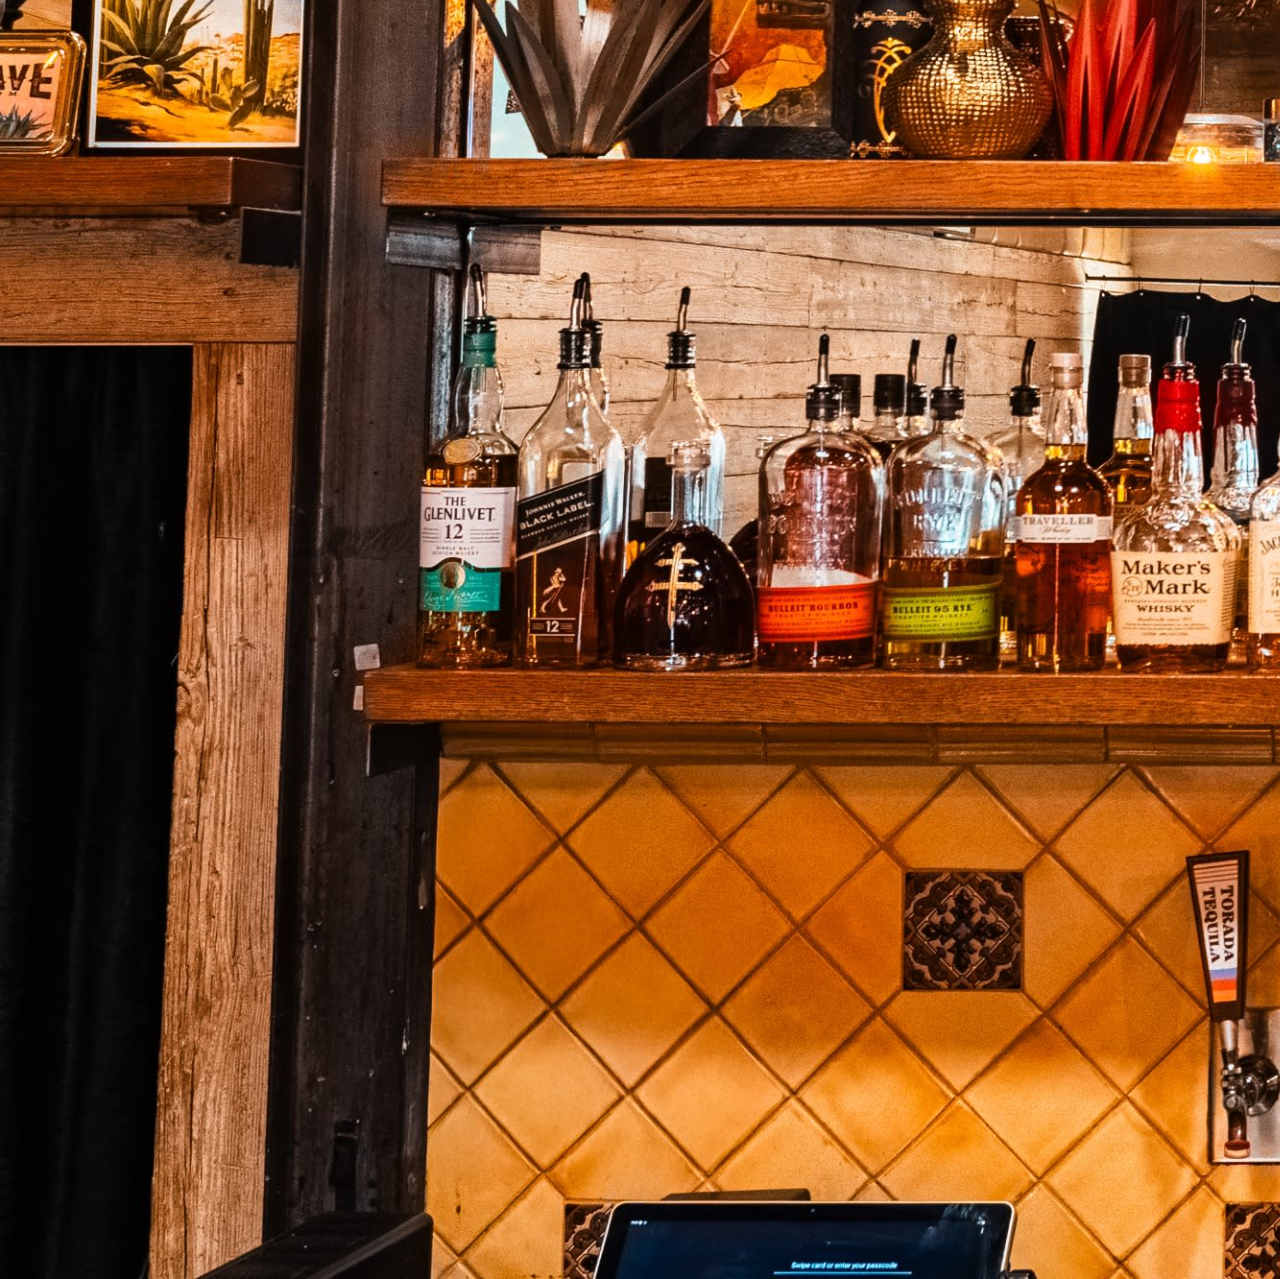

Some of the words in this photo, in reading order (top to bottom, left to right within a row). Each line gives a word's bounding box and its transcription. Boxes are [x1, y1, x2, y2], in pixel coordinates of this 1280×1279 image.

[444, 497, 466, 507] THE
[424, 507, 496, 522] GLENLIVET
[1023, 516, 1093, 526] TRAVELLER
[519, 514, 555, 531] BLACK
[445, 524, 463, 540] 12
[1121, 560, 1211, 575] Maker's
[1145, 579, 1209, 595] Mark
[1137, 604, 1195, 613] WHISKY
[545, 620, 560, 633] 12
[1202, 886, 1221, 963] TEQUILA
[1220, 885, 1235, 962] TORADA
